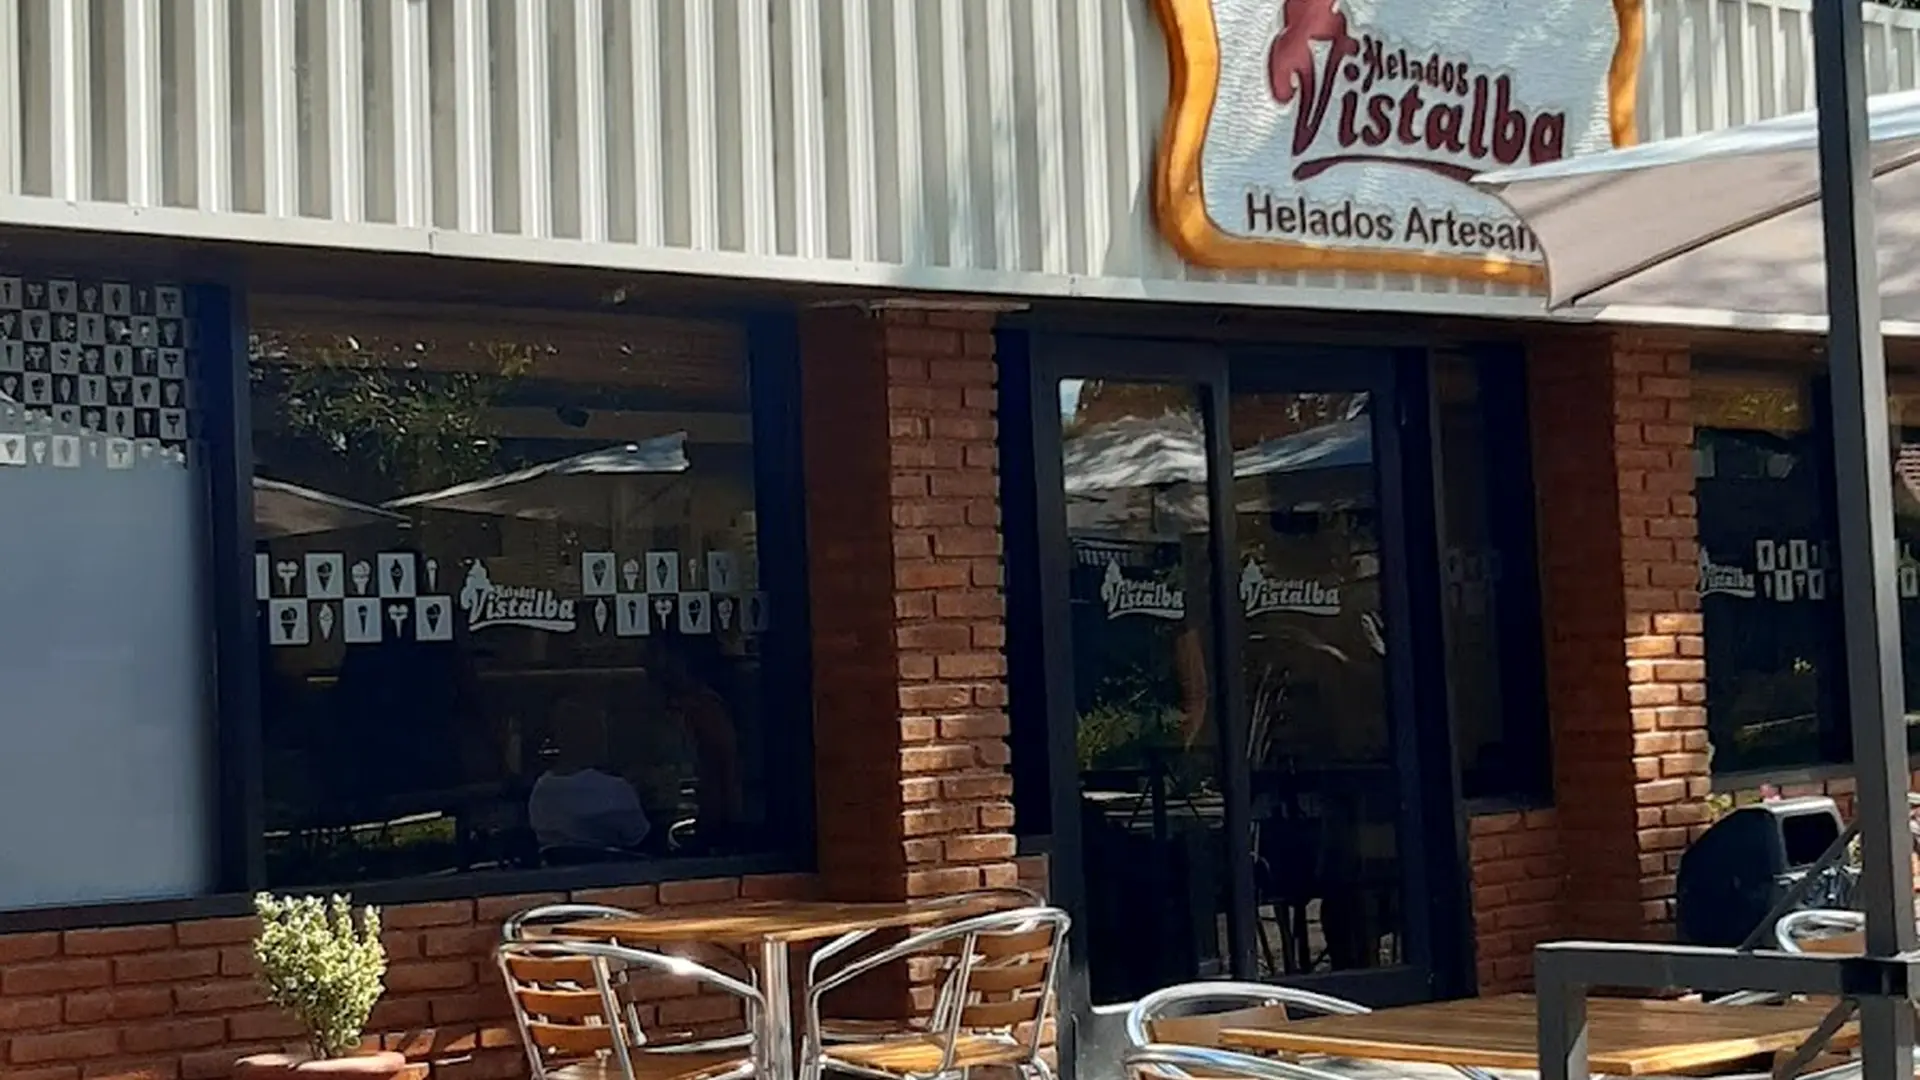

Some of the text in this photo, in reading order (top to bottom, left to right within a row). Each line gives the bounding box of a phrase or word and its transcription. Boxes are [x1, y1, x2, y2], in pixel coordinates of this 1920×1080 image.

[1361, 35, 1469, 96] Helados
[1291, 40, 1566, 165] Vistalba
[1246, 192, 1394, 242] Helados
[468, 588, 576, 624] Vistalba
[1107, 583, 1185, 613] Vistalba
[1245, 581, 1340, 611] Vistalba
